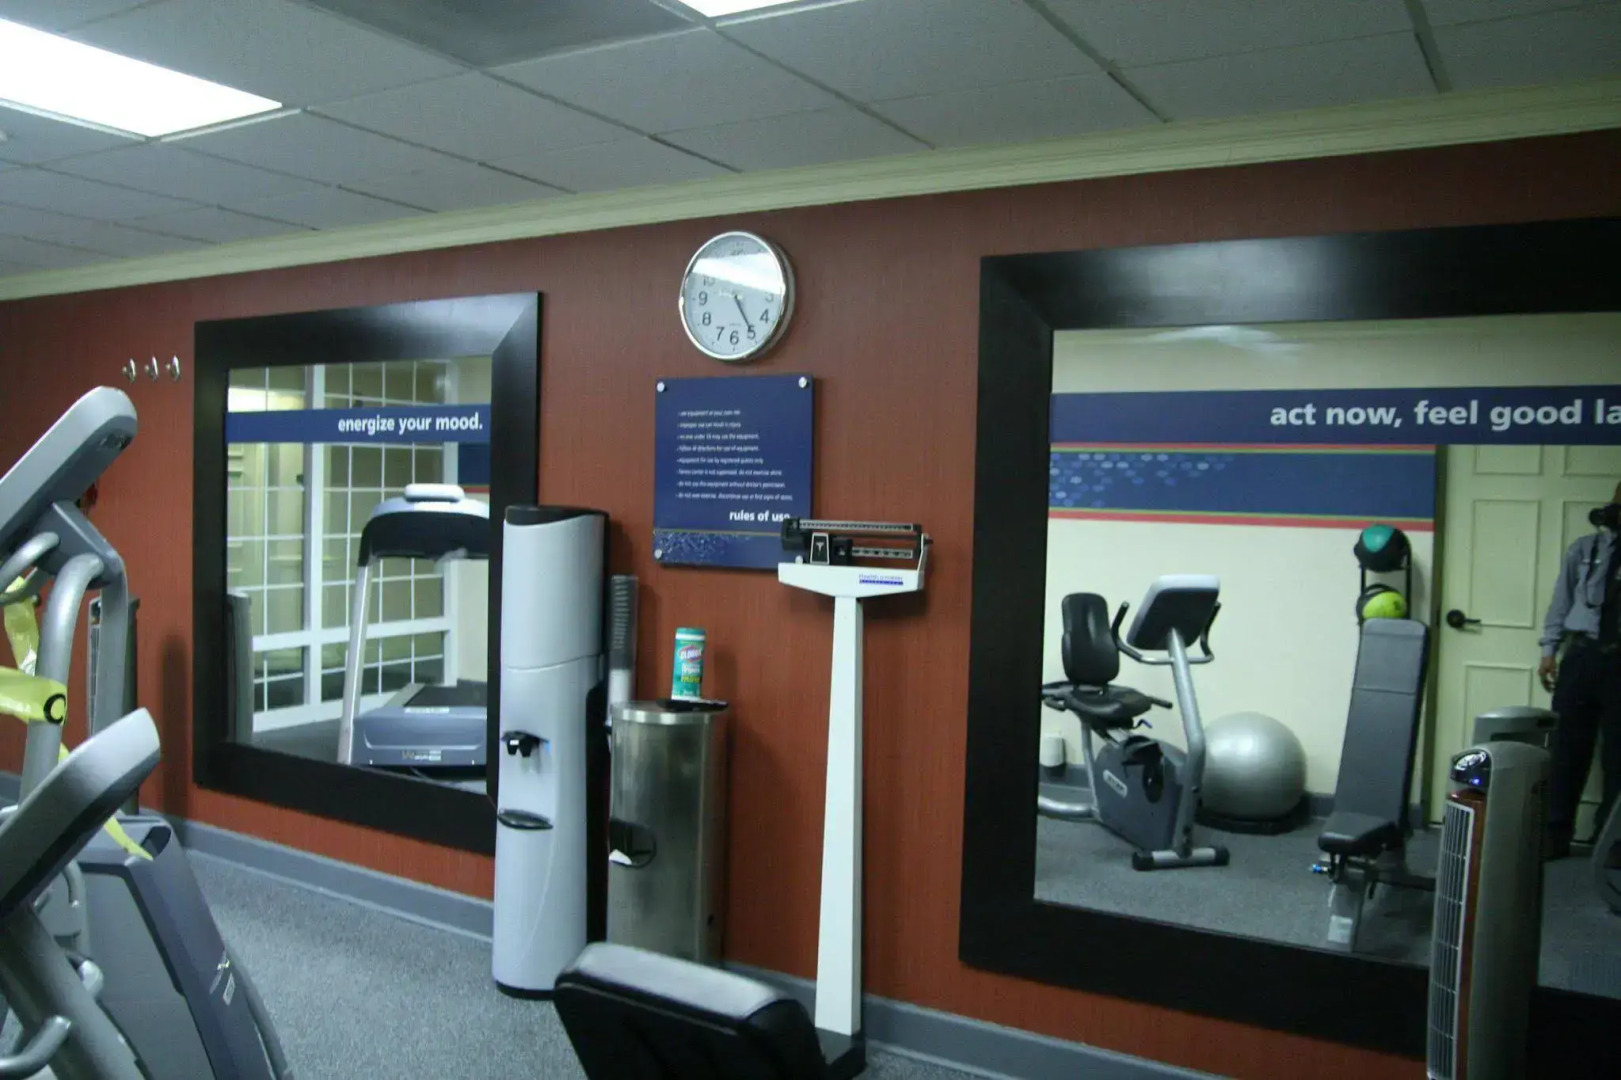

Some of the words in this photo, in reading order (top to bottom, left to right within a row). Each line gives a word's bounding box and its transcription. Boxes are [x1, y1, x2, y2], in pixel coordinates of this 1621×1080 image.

[698, 291, 708, 306] 9
[702, 312, 712, 326] 8
[760, 308, 770, 323] 4
[716, 326, 726, 341] 7
[729, 330, 739, 346] 6
[747, 325, 756, 340] 5
[1270, 403, 1316, 426] act
[1325, 404, 1402, 428] now,
[1414, 400, 1479, 425] feel
[1489, 399, 1583, 432] good
[338, 413, 395, 436] energize
[398, 416, 432, 435] your
[435, 412, 483, 430] mood.
[729, 510, 755, 521] rules
[757, 510, 770, 522] of
